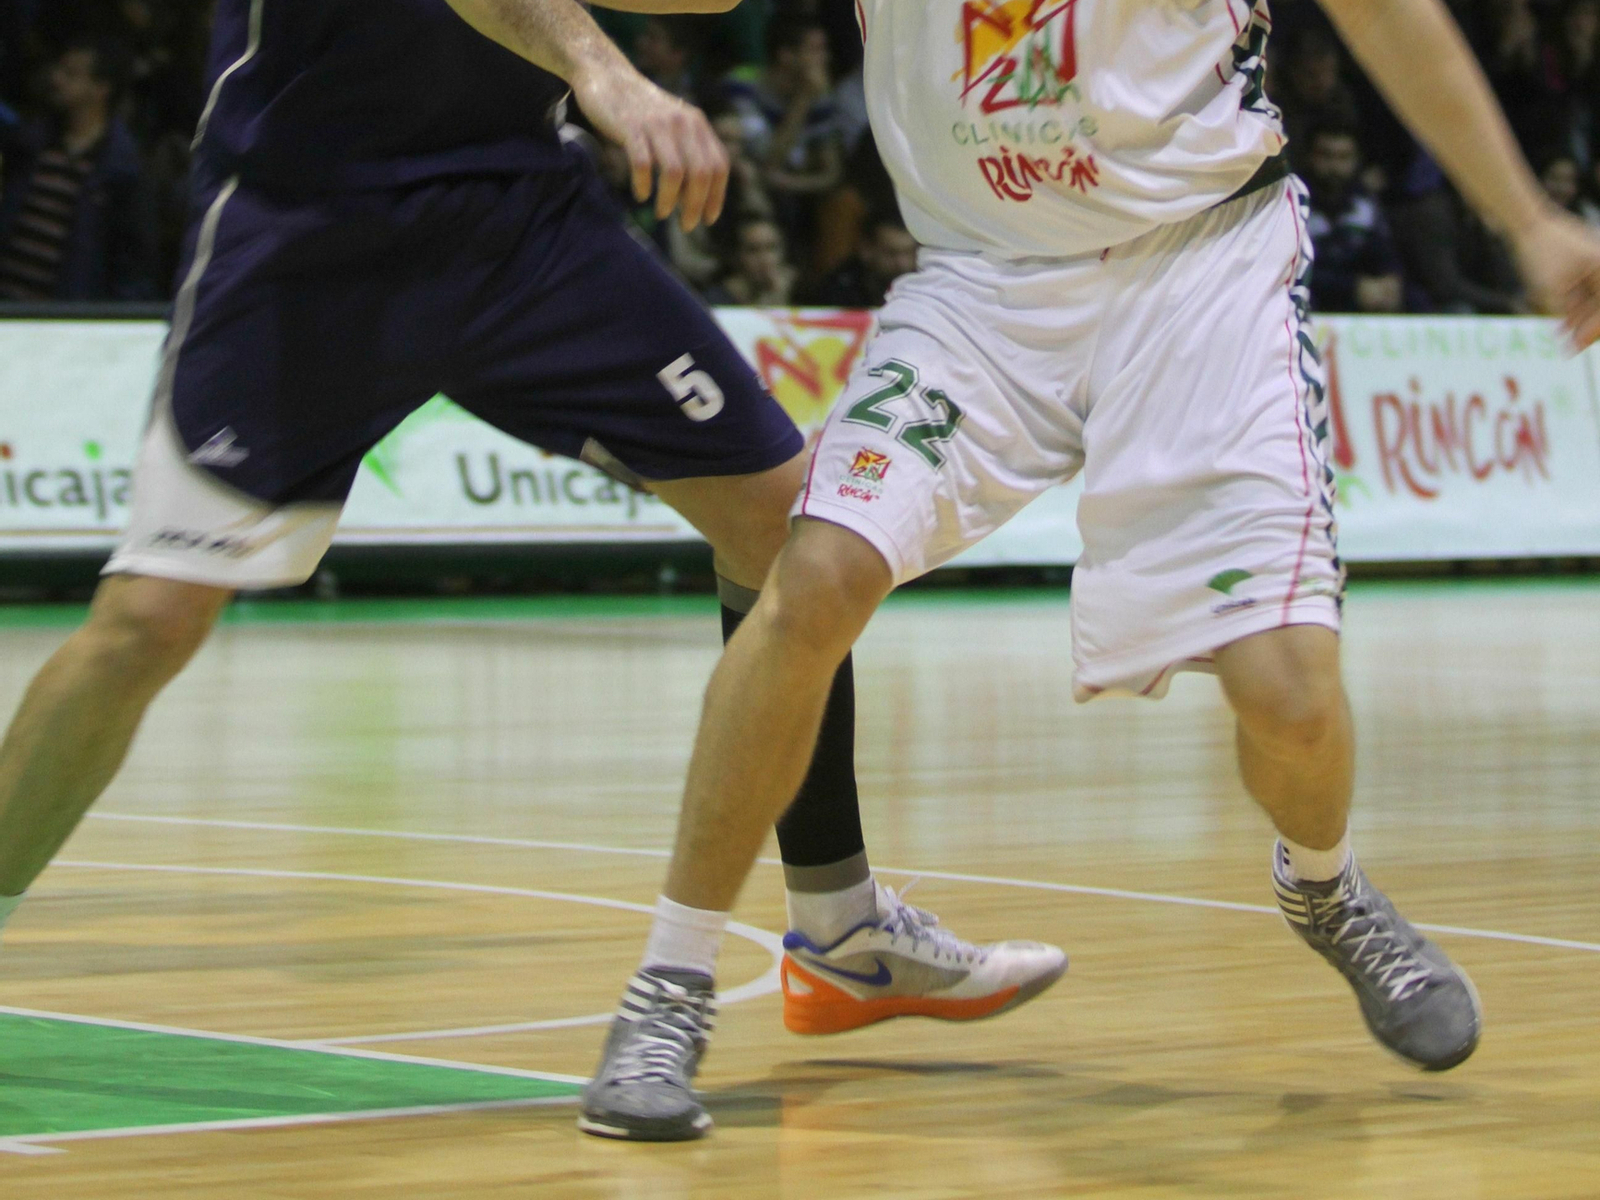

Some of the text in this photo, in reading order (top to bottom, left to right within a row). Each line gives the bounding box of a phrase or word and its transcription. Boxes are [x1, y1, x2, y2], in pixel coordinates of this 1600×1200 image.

[1348, 324, 1556, 361] CLINICAS
[655, 351, 725, 422] 5
[841, 357, 966, 474] 22
